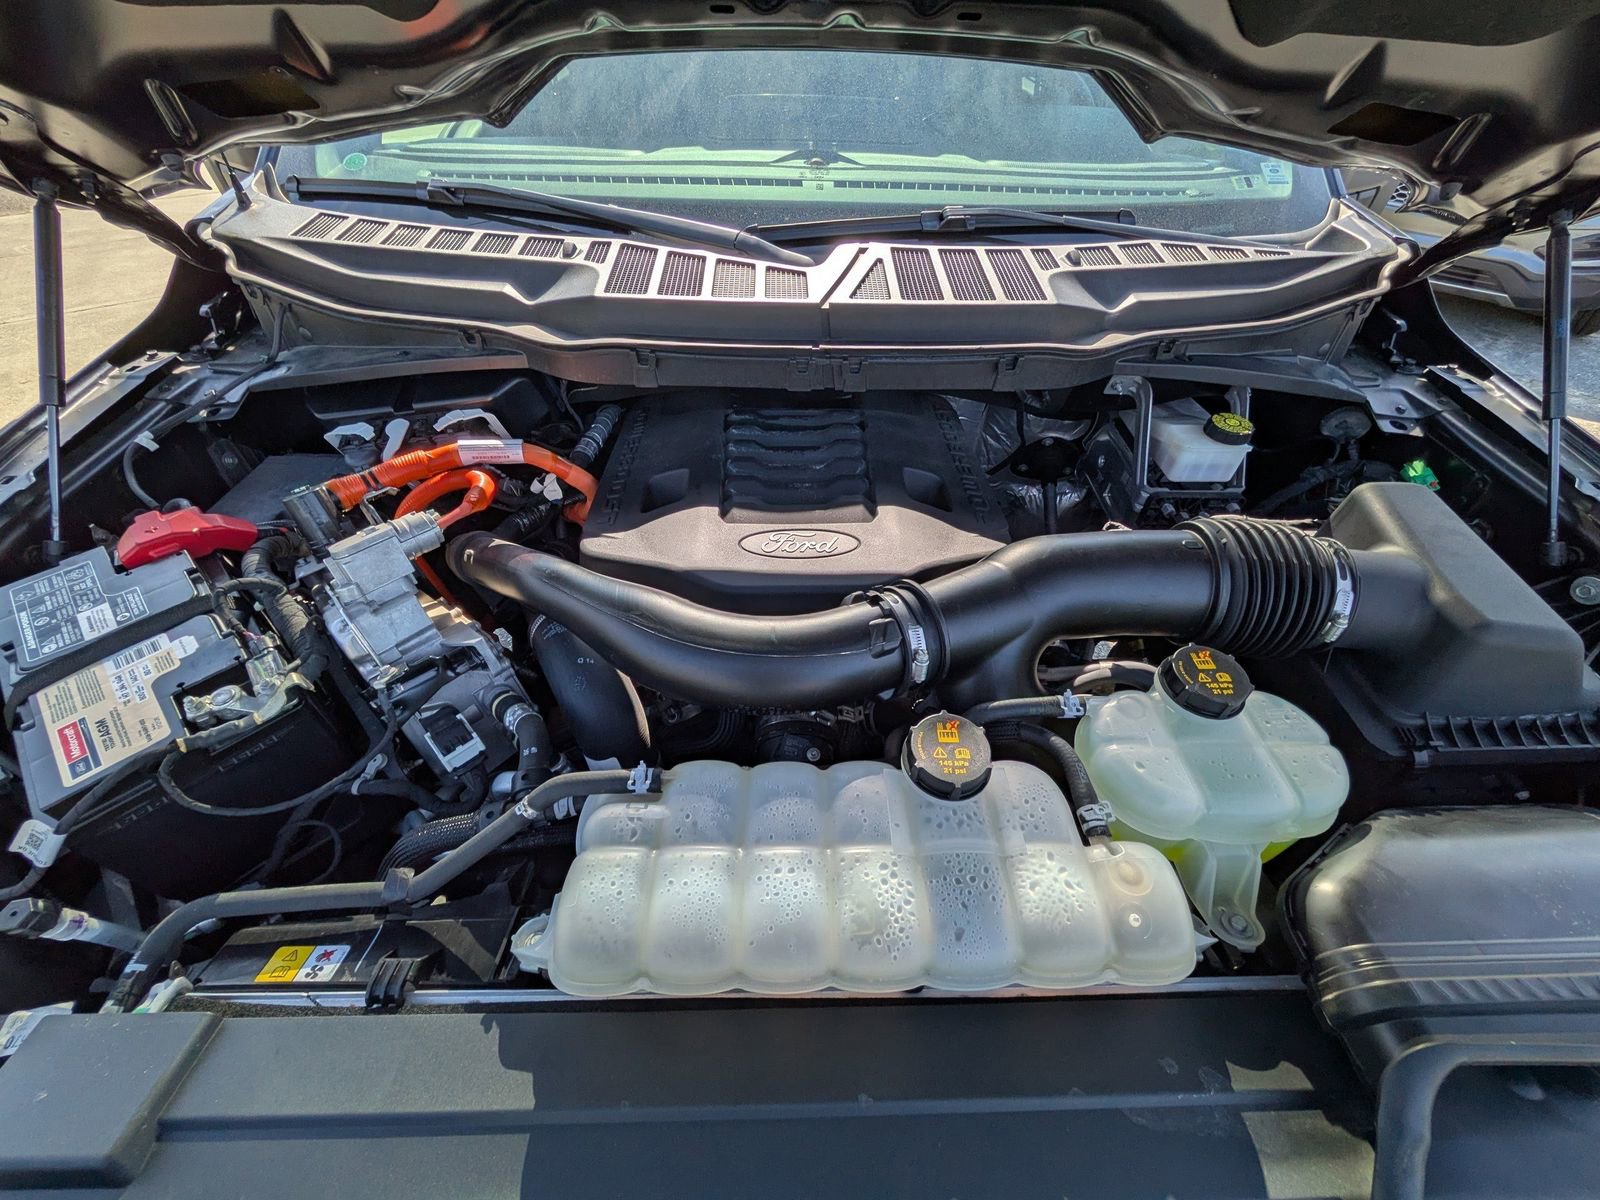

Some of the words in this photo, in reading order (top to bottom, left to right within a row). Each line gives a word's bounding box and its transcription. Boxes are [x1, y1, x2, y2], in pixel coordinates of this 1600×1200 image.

[760, 530, 839, 555] Ford
[94, 717, 111, 738] AGM
[66, 726, 82, 758] Motorcraft
